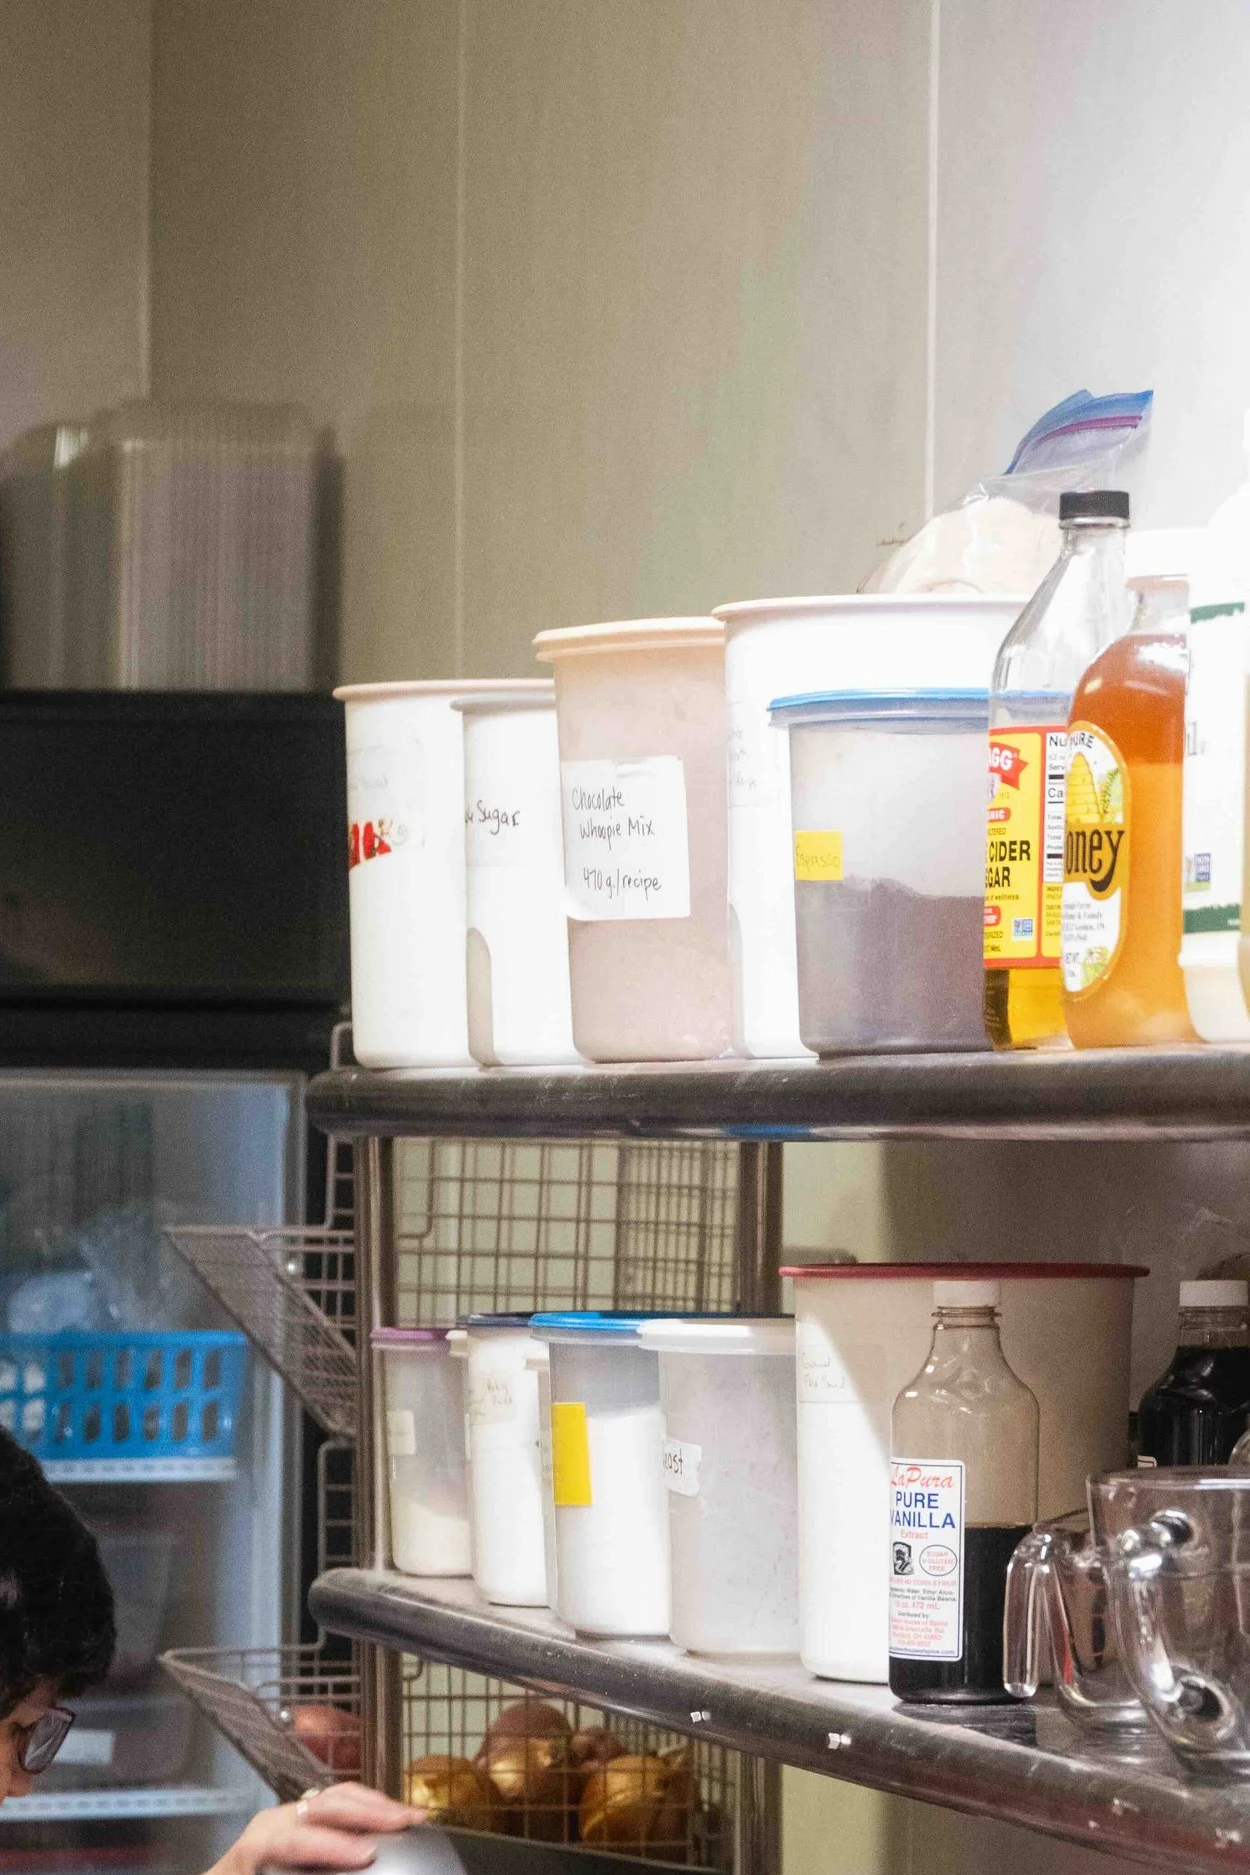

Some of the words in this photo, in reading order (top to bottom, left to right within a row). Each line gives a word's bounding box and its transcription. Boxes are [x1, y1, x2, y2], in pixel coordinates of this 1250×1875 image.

[571, 786, 625, 812] Chocolate
[476, 800, 521, 835] Sugar
[628, 815, 654, 837] Mix
[988, 840, 1032, 862] CIDER
[1065, 827, 1125, 893] oney
[890, 1465, 954, 1489] LaPura
[895, 1490, 940, 1509] PURE
[890, 1509, 956, 1529] VANILLA
[900, 1529, 929, 1540] Extract
